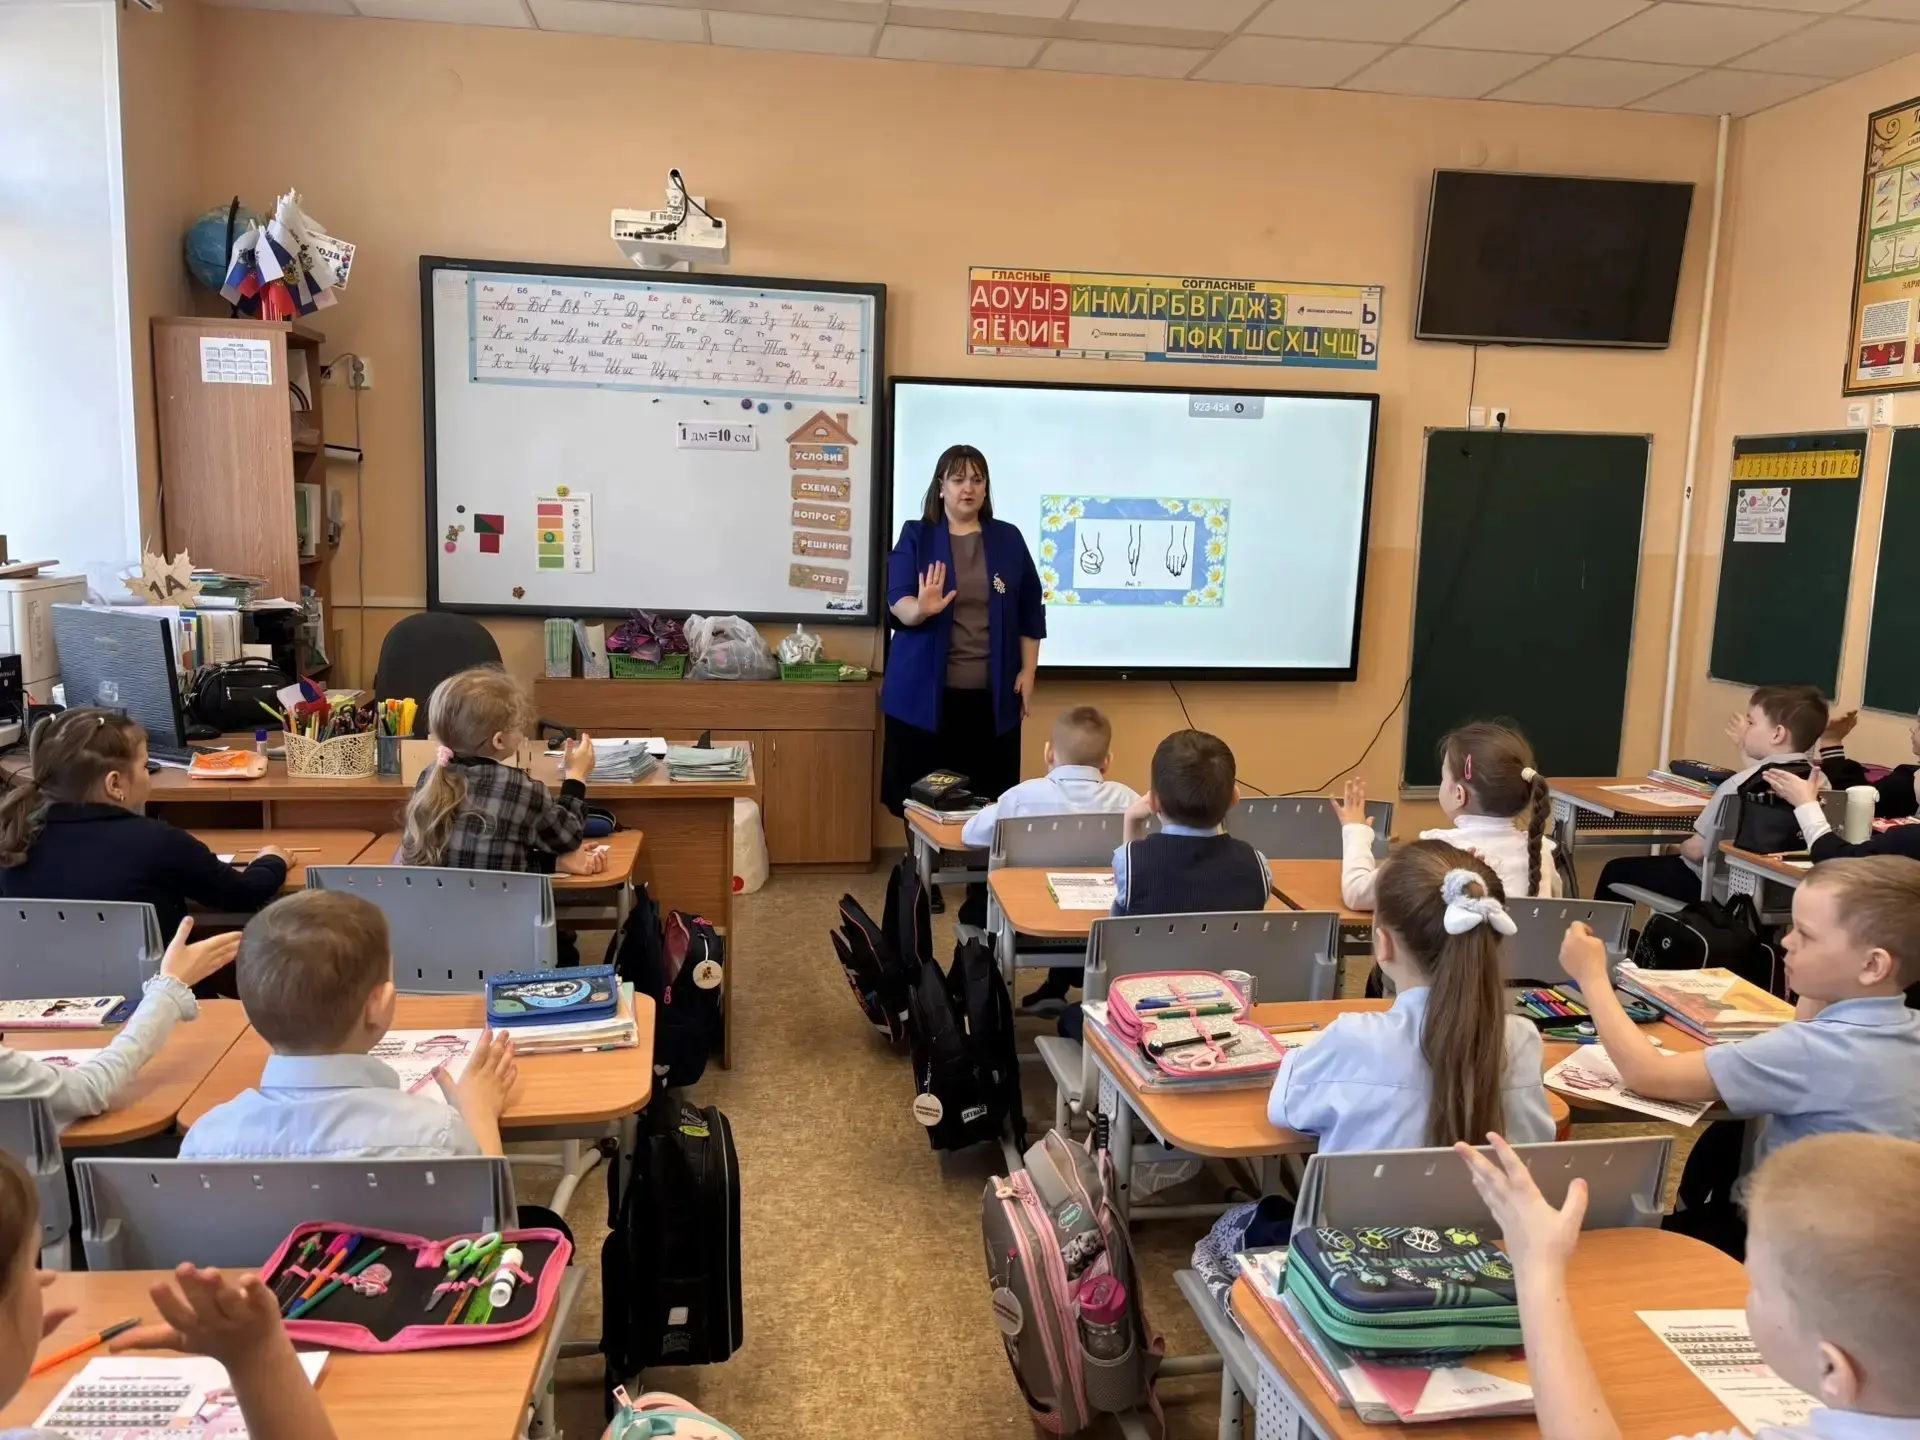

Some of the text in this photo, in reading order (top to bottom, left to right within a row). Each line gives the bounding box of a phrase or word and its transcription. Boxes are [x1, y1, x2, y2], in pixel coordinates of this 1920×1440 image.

[315, 245, 340, 260] ола
[992, 270, 1051, 282] ГЛАСНЫЕ
[1182, 279, 1256, 291] СОГЛАСНЫЕ
[681, 427, 687, 440] 1
[735, 434, 751, 443] см
[795, 452, 844, 462] УСЛОВИЕ
[801, 483, 837, 493] СХЕМА
[794, 511, 836, 522] ВОПРОС
[800, 539, 848, 551] РЕШЕНИЕ
[811, 574, 844, 585] ОТВЕТ
[149, 575, 187, 600] 1А
